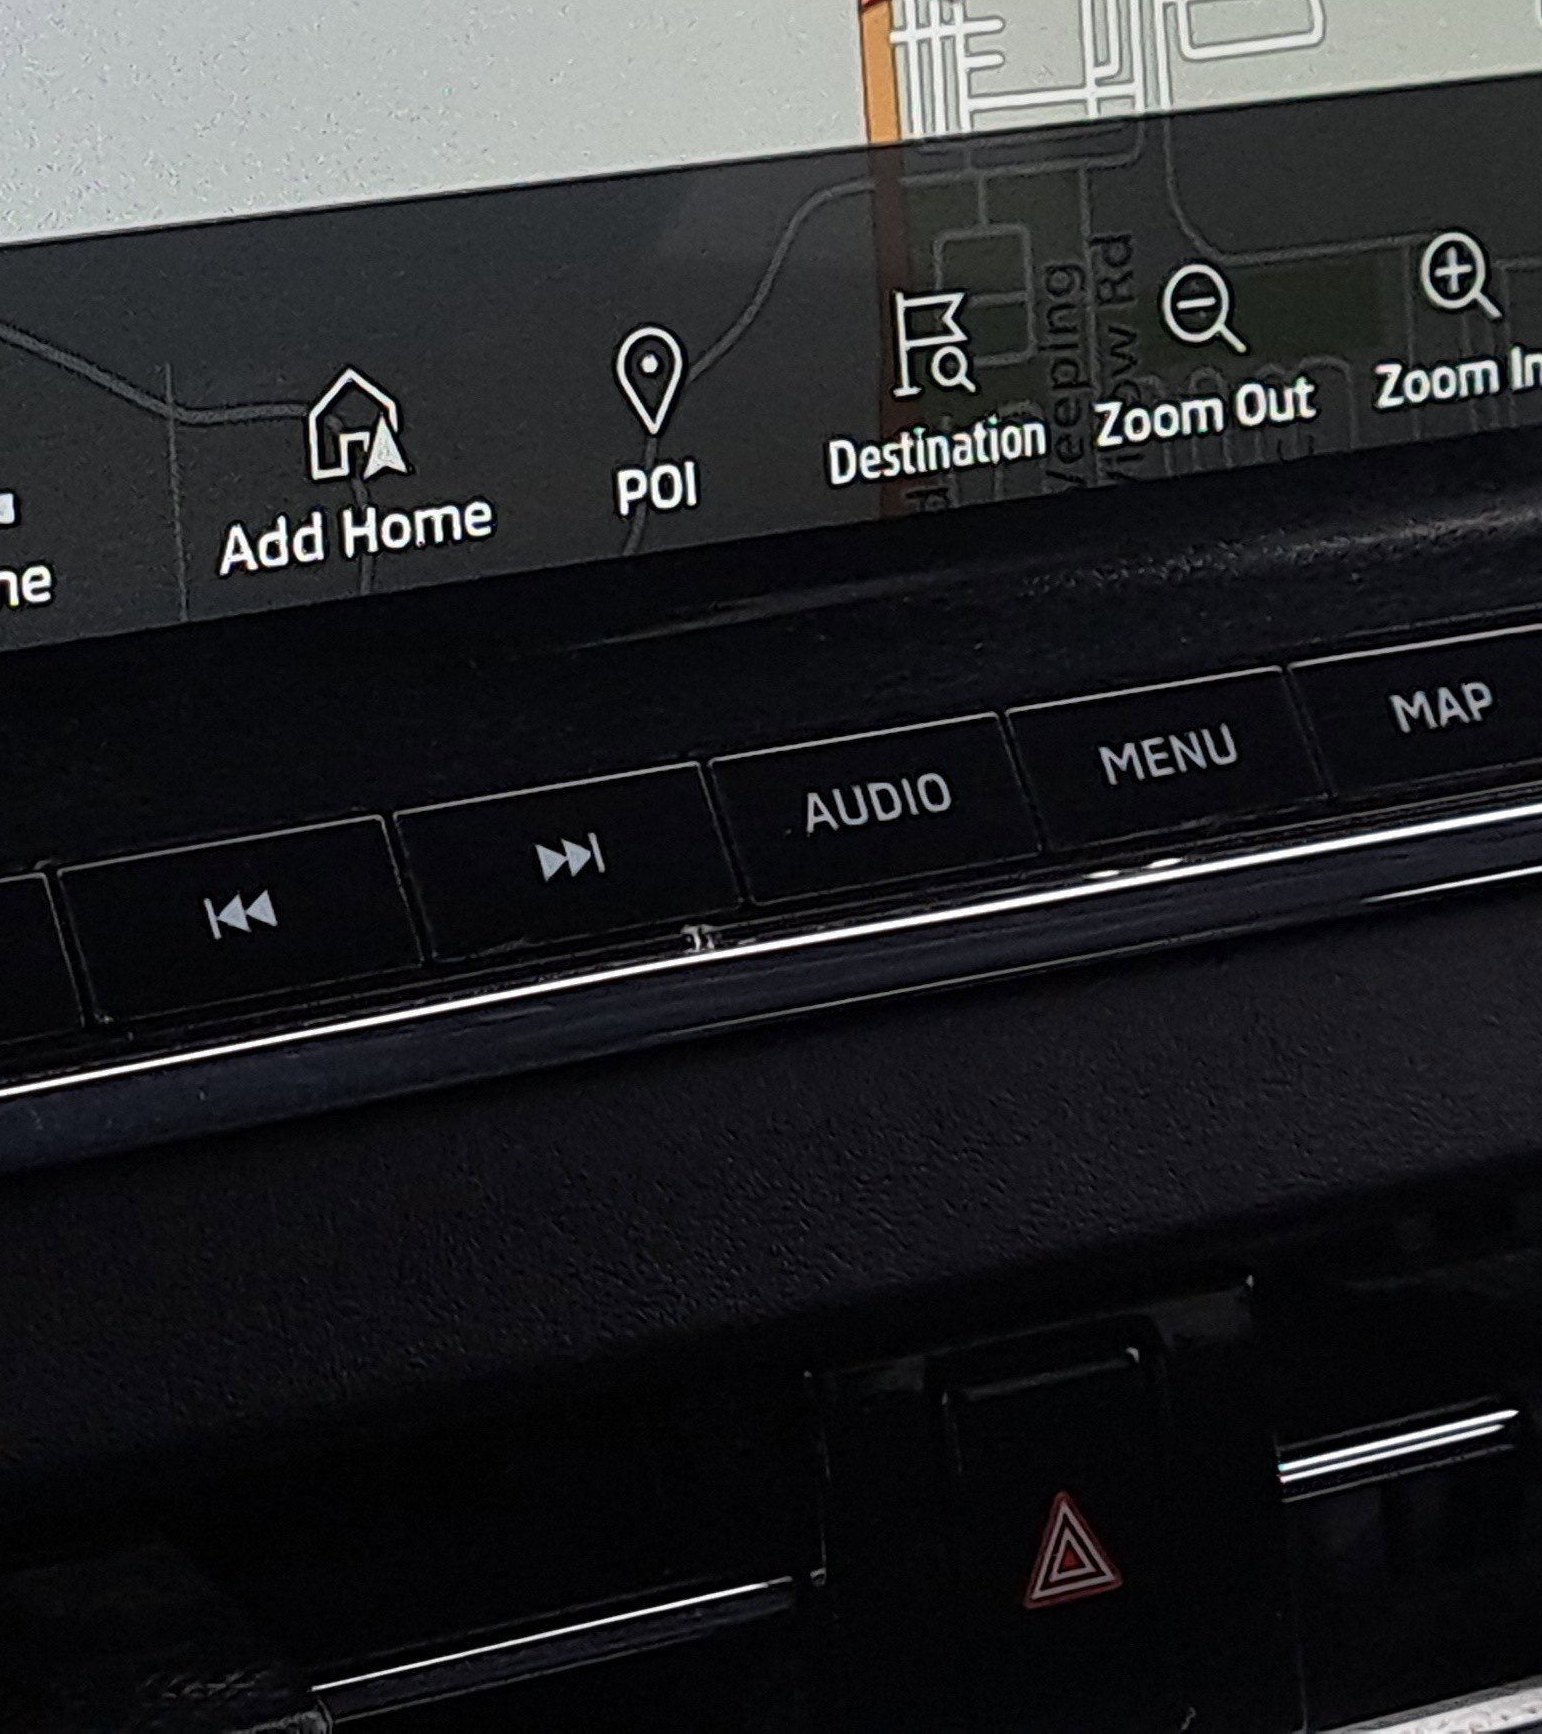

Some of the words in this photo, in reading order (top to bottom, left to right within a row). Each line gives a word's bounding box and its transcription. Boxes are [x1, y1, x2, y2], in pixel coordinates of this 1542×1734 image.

[1093, 396, 1225, 448] Zoom
[1234, 376, 1318, 429] Out
[1374, 358, 1500, 411] Zoom
[828, 413, 1047, 486] Destination
[616, 460, 698, 517] POI
[218, 510, 325, 577] Add
[341, 500, 494, 559] Home
[1388, 681, 1493, 734] MAP
[1097, 722, 1239, 786] MENU
[804, 771, 953, 834] AUDIO
